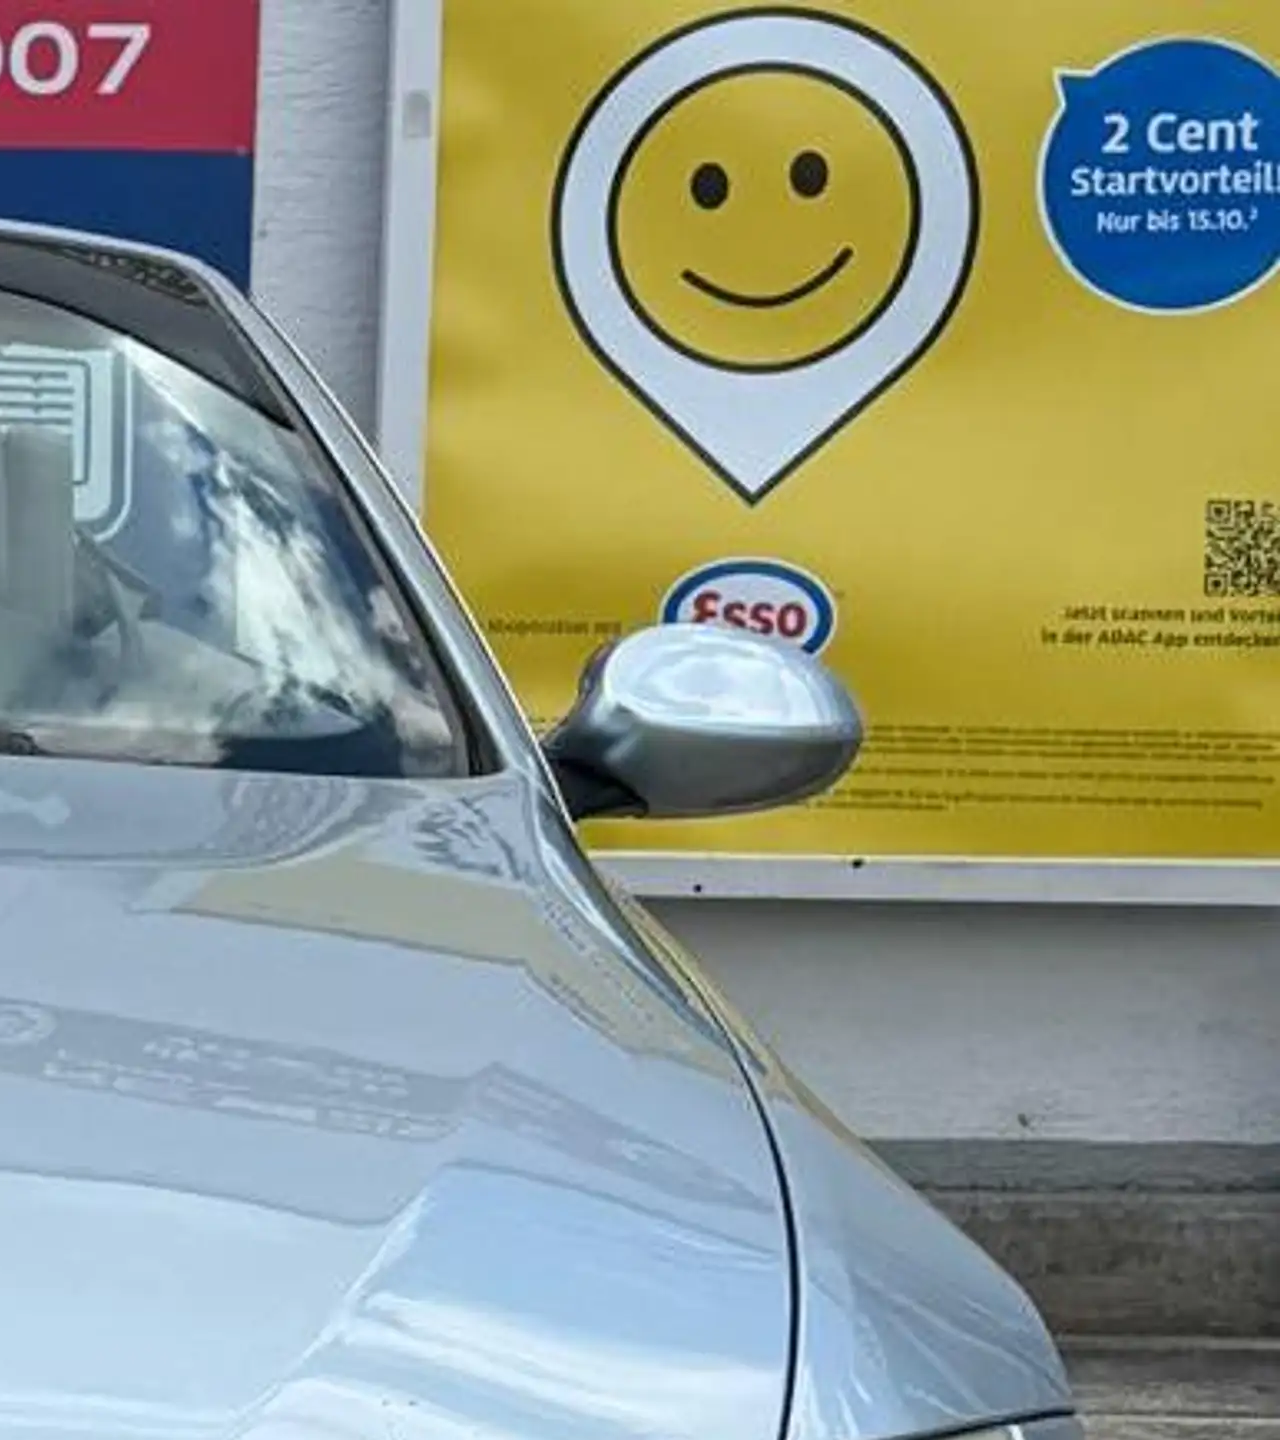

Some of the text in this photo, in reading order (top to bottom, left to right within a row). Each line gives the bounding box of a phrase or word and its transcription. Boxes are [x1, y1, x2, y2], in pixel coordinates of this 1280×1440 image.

[1101, 111, 1260, 154] 2 Cent
[1096, 211, 1142, 233] Nur
[1146, 208, 1179, 232] bis
[691, 589, 808, 638] Esso
[1190, 606, 1226, 623] und
[1096, 627, 1149, 646] ADAC
[1152, 629, 1189, 649] App
